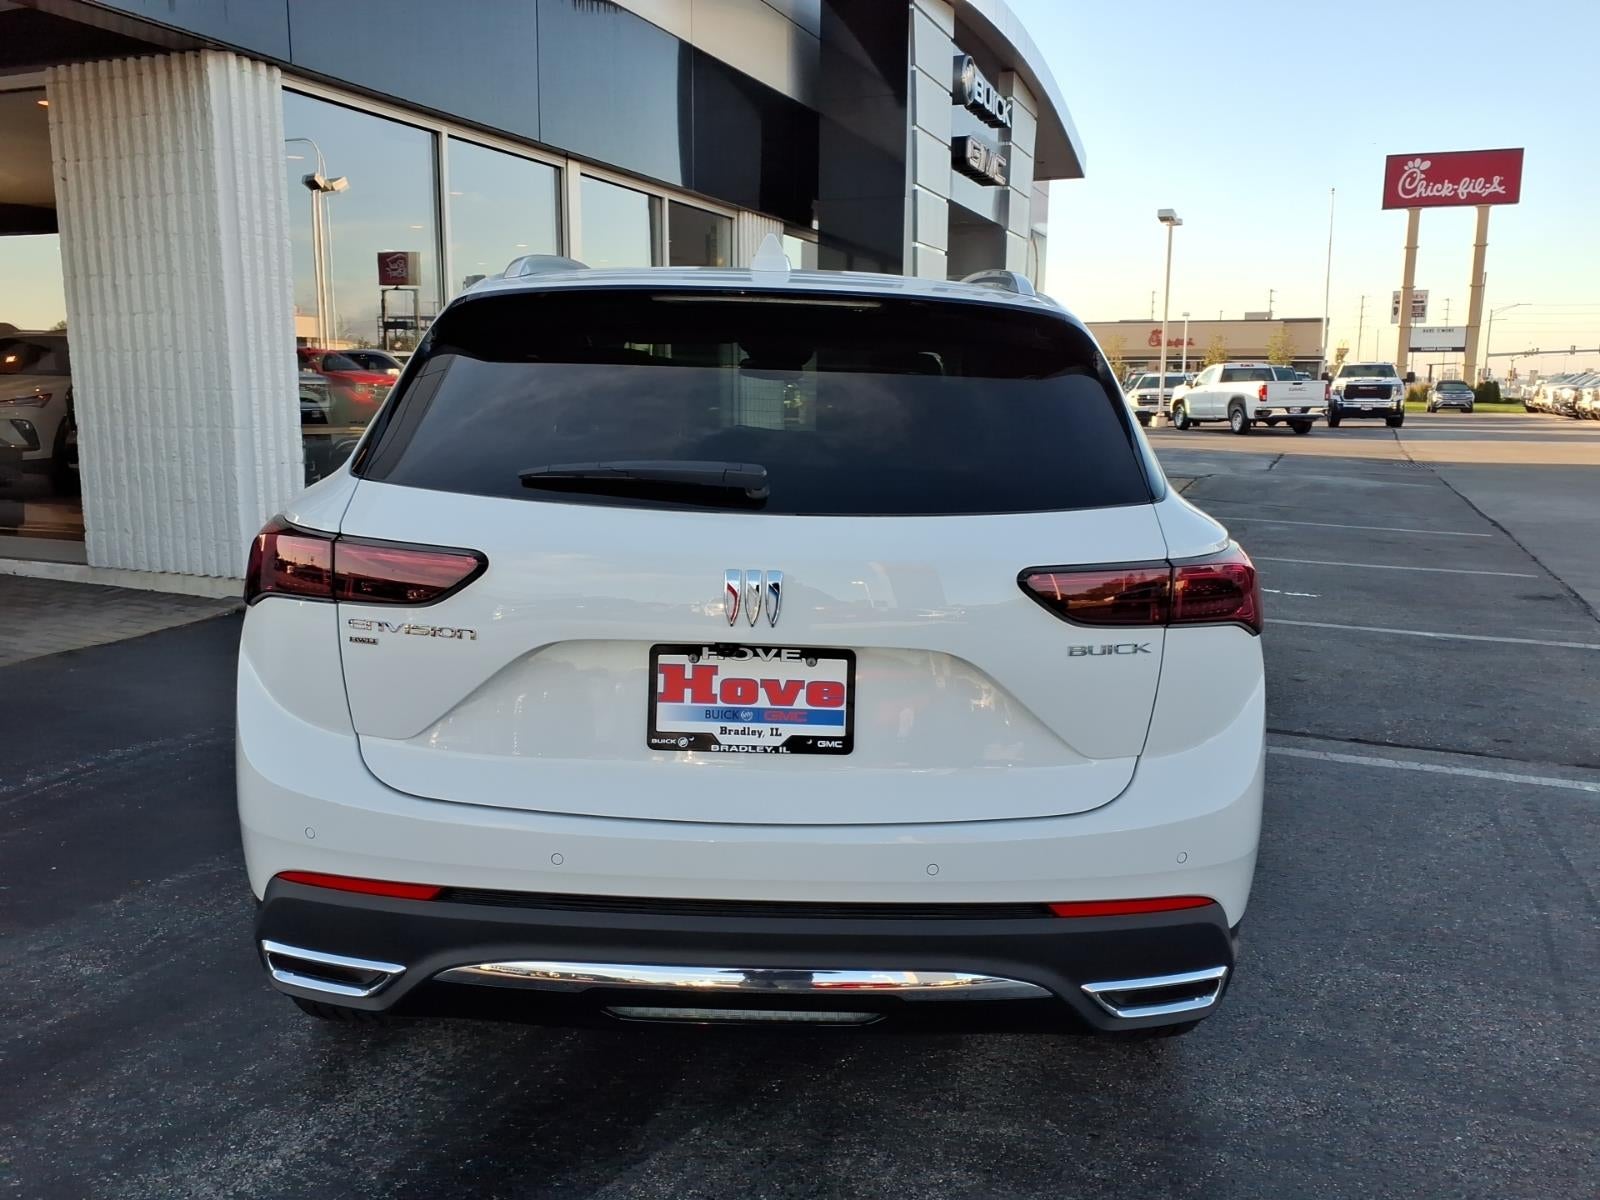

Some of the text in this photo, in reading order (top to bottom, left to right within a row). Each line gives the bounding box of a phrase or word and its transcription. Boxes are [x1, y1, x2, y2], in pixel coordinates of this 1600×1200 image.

[975, 79, 1011, 128] BUICK
[1398, 160, 1506, 199] Chick-fil-A
[1067, 642, 1152, 657] BUICK
[658, 663, 845, 708] Hove
[705, 709, 807, 722] BUICK GMC
[719, 725, 782, 738] Bradley, IL
[710, 744, 776, 754] BRADLEY,
[817, 740, 843, 749] GMC
